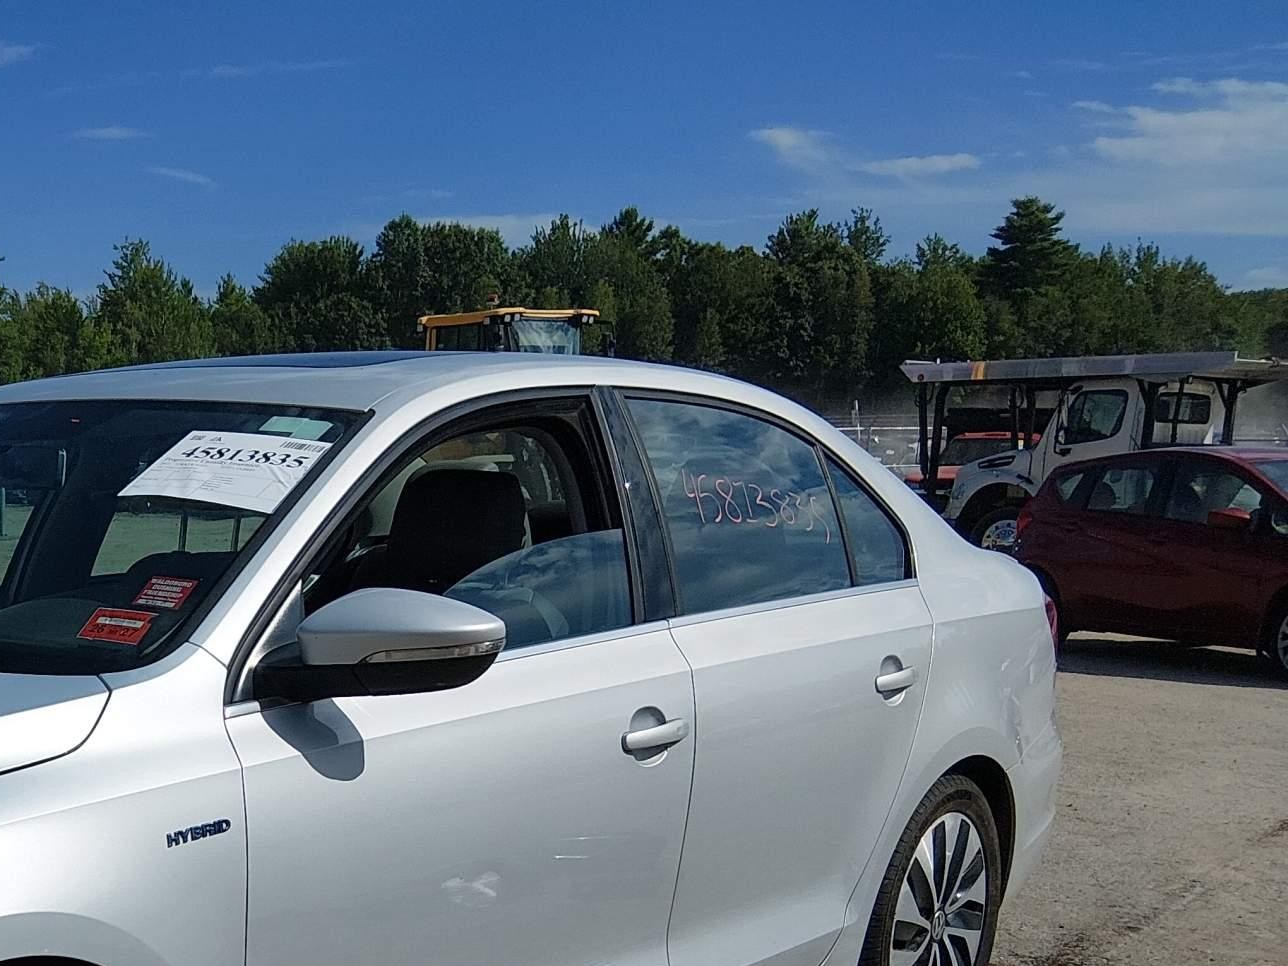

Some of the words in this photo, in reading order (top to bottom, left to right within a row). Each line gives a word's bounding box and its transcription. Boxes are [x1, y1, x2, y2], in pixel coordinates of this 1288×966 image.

[181, 446, 310, 468] 45813835
[681, 468, 831, 545] 45813835
[166, 818, 232, 848] HYBRID
